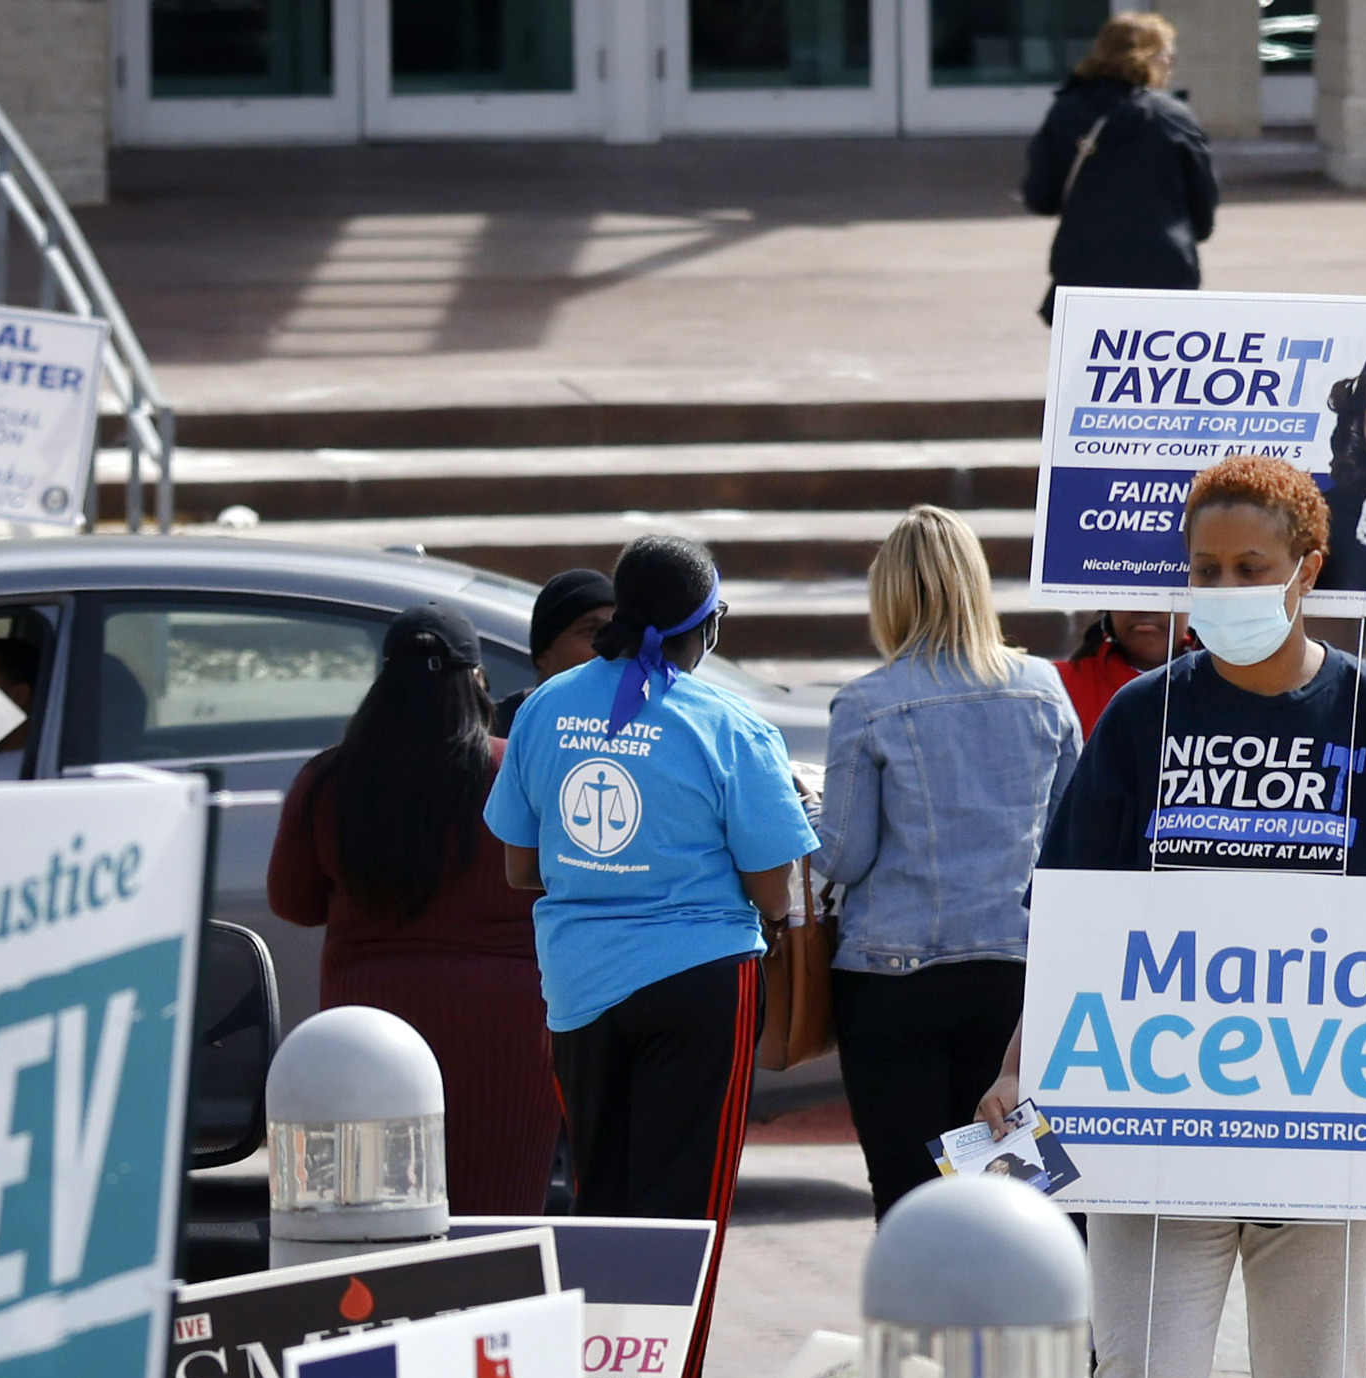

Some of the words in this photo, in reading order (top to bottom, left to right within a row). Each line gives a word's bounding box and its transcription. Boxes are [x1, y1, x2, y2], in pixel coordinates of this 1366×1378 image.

[1089, 330, 1266, 363] NICOLE
[1085, 365, 1282, 407] TAYLOR
[1080, 415, 1195, 433] DEMOCRAT
[1198, 417, 1239, 433] FOR
[1241, 418, 1307, 435] JUDGE
[1074, 440, 1152, 456] COUNTY
[1156, 443, 1222, 458] COURT
[1223, 445, 1247, 457] AT
[1251, 445, 1291, 458] LAW
[1293, 446, 1303, 459] 5
[1078, 509, 1173, 532] COMES
[556, 716, 663, 741] DEMOCATIC
[559, 735, 652, 757] CANVASSER
[1164, 735, 1314, 769] NICOLE
[1161, 768, 1327, 810] TAYLOR
[1157, 814, 1251, 834] DEMOCRAT
[1254, 817, 1286, 834] FOR
[1290, 818, 1345, 839] JUDGE
[1149, 840, 1213, 857] COUNTY
[1216, 841, 1273, 859] COURT
[1275, 843, 1297, 859] AT
[1299, 845, 1334, 861] LAW
[1336, 847, 1344, 862] 5
[1050, 1116, 1166, 1138] DEMOCRAT
[1170, 1118, 1214, 1138] FOR
[1218, 1120, 1280, 1141] 192ND
[584, 1335, 668, 1373] OPE
